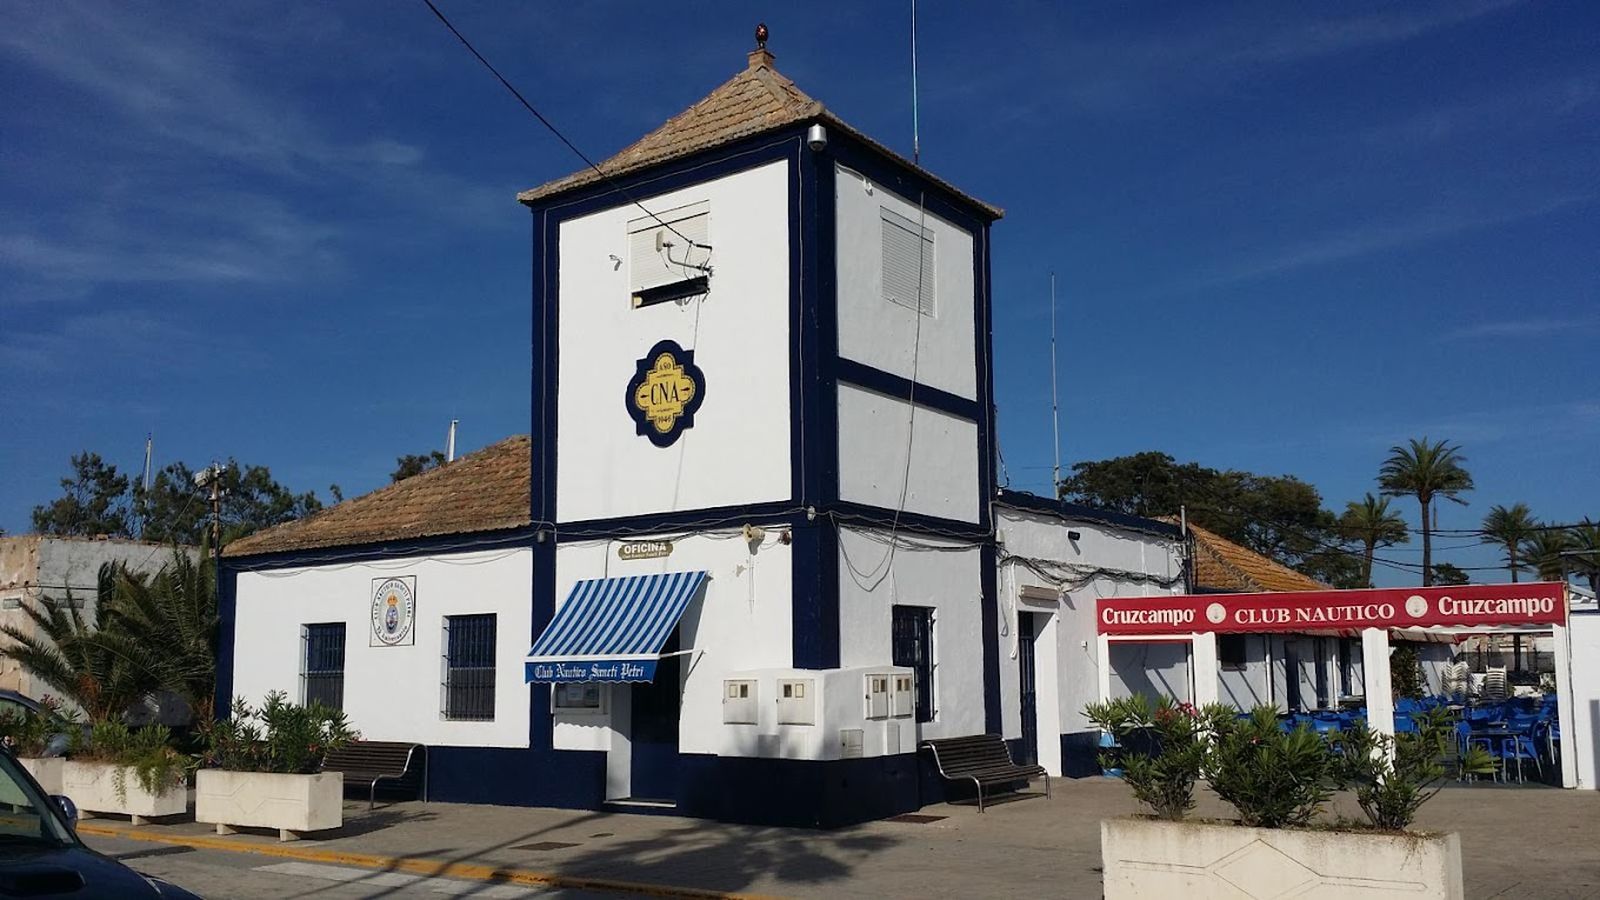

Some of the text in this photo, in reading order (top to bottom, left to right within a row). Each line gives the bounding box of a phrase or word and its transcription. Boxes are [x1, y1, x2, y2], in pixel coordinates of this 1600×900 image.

[650, 381, 679, 405] CNA
[624, 543, 667, 554] OFICINA
[1234, 603, 1395, 624] CLUB NAUTICO
[1438, 595, 1554, 617] Cruzcampo
[1102, 607, 1194, 627] Cruzcampo
[534, 664, 553, 679] Club
[620, 663, 644, 679] Petri
